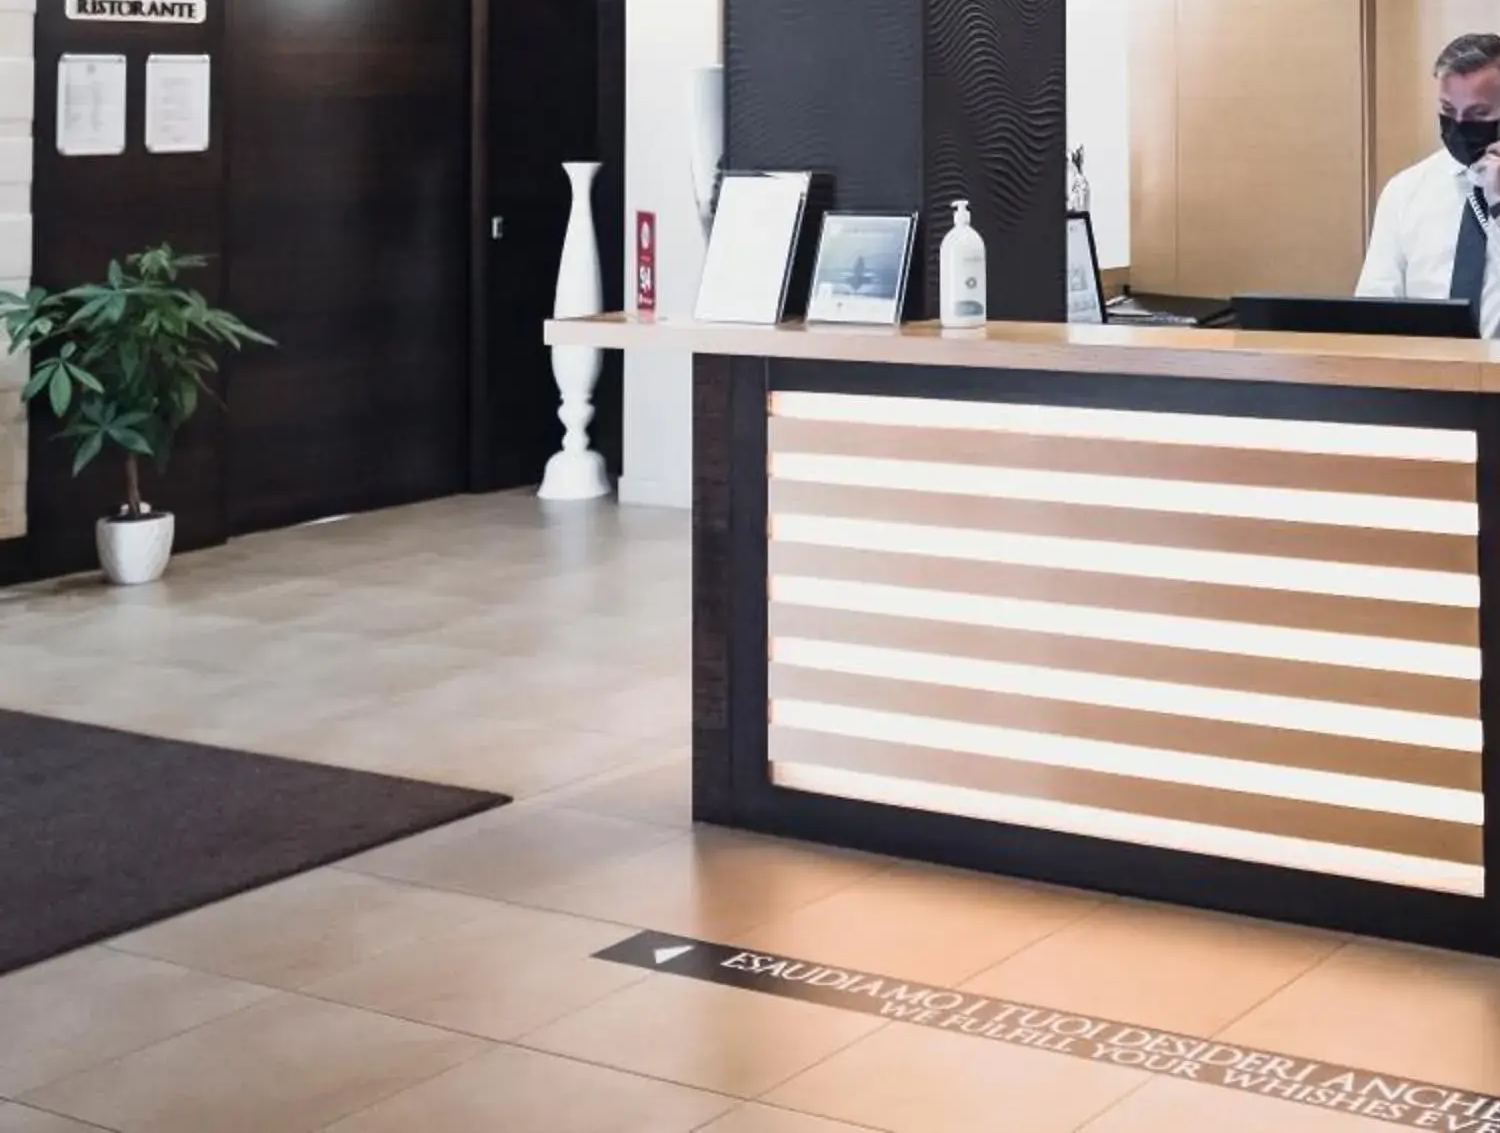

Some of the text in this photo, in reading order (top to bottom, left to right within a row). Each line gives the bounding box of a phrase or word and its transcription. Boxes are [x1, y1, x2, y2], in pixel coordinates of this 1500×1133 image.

[720, 952, 963, 1009] ESAUDIAMO
[963, 998, 990, 1016] I
[994, 1003, 1111, 1039] TUOI
[1108, 1027, 1320, 1081] DESIDERI
[880, 1001, 941, 1024] WE
[941, 1015, 1076, 1052] FULFILL
[1092, 1043, 1201, 1078] YOUR
[1223, 1069, 1409, 1119] WHISHES
